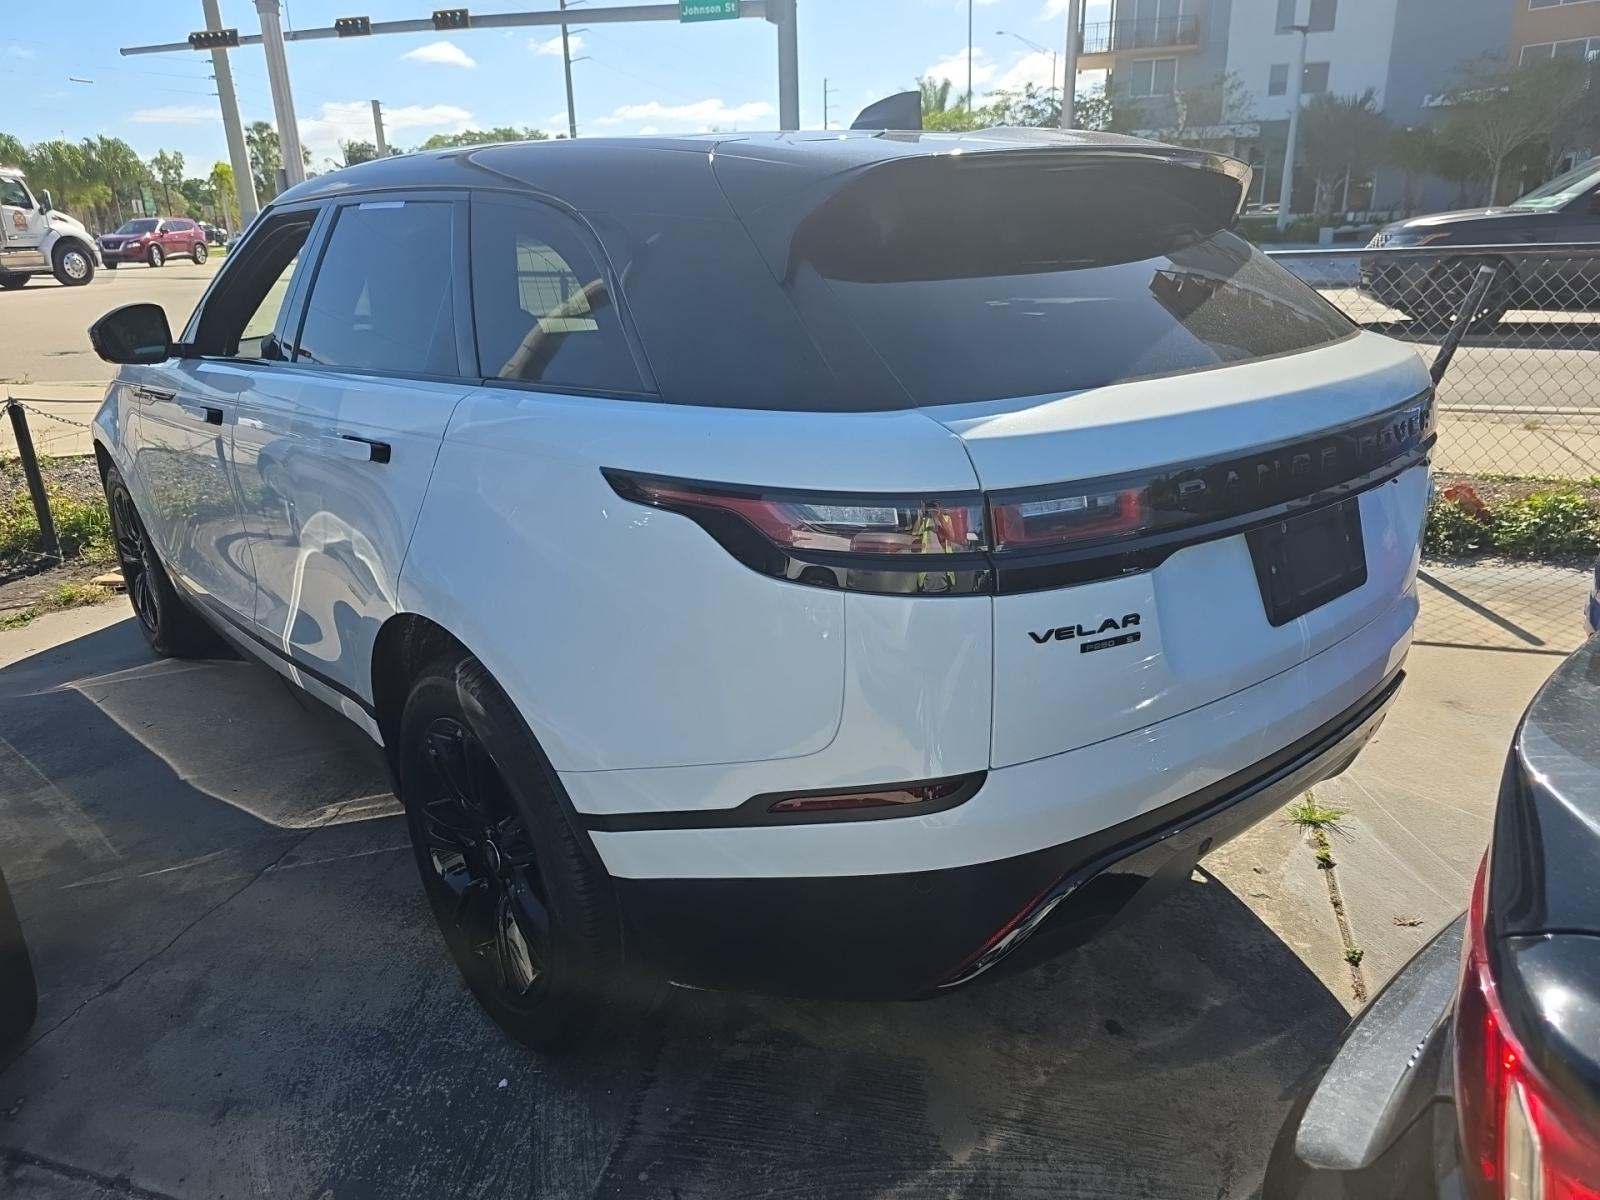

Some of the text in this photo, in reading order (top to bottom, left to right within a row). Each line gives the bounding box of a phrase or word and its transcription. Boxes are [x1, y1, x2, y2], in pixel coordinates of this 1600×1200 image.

[683, 2, 735, 16] Johnson St
[1027, 613, 1141, 644] VELAR
